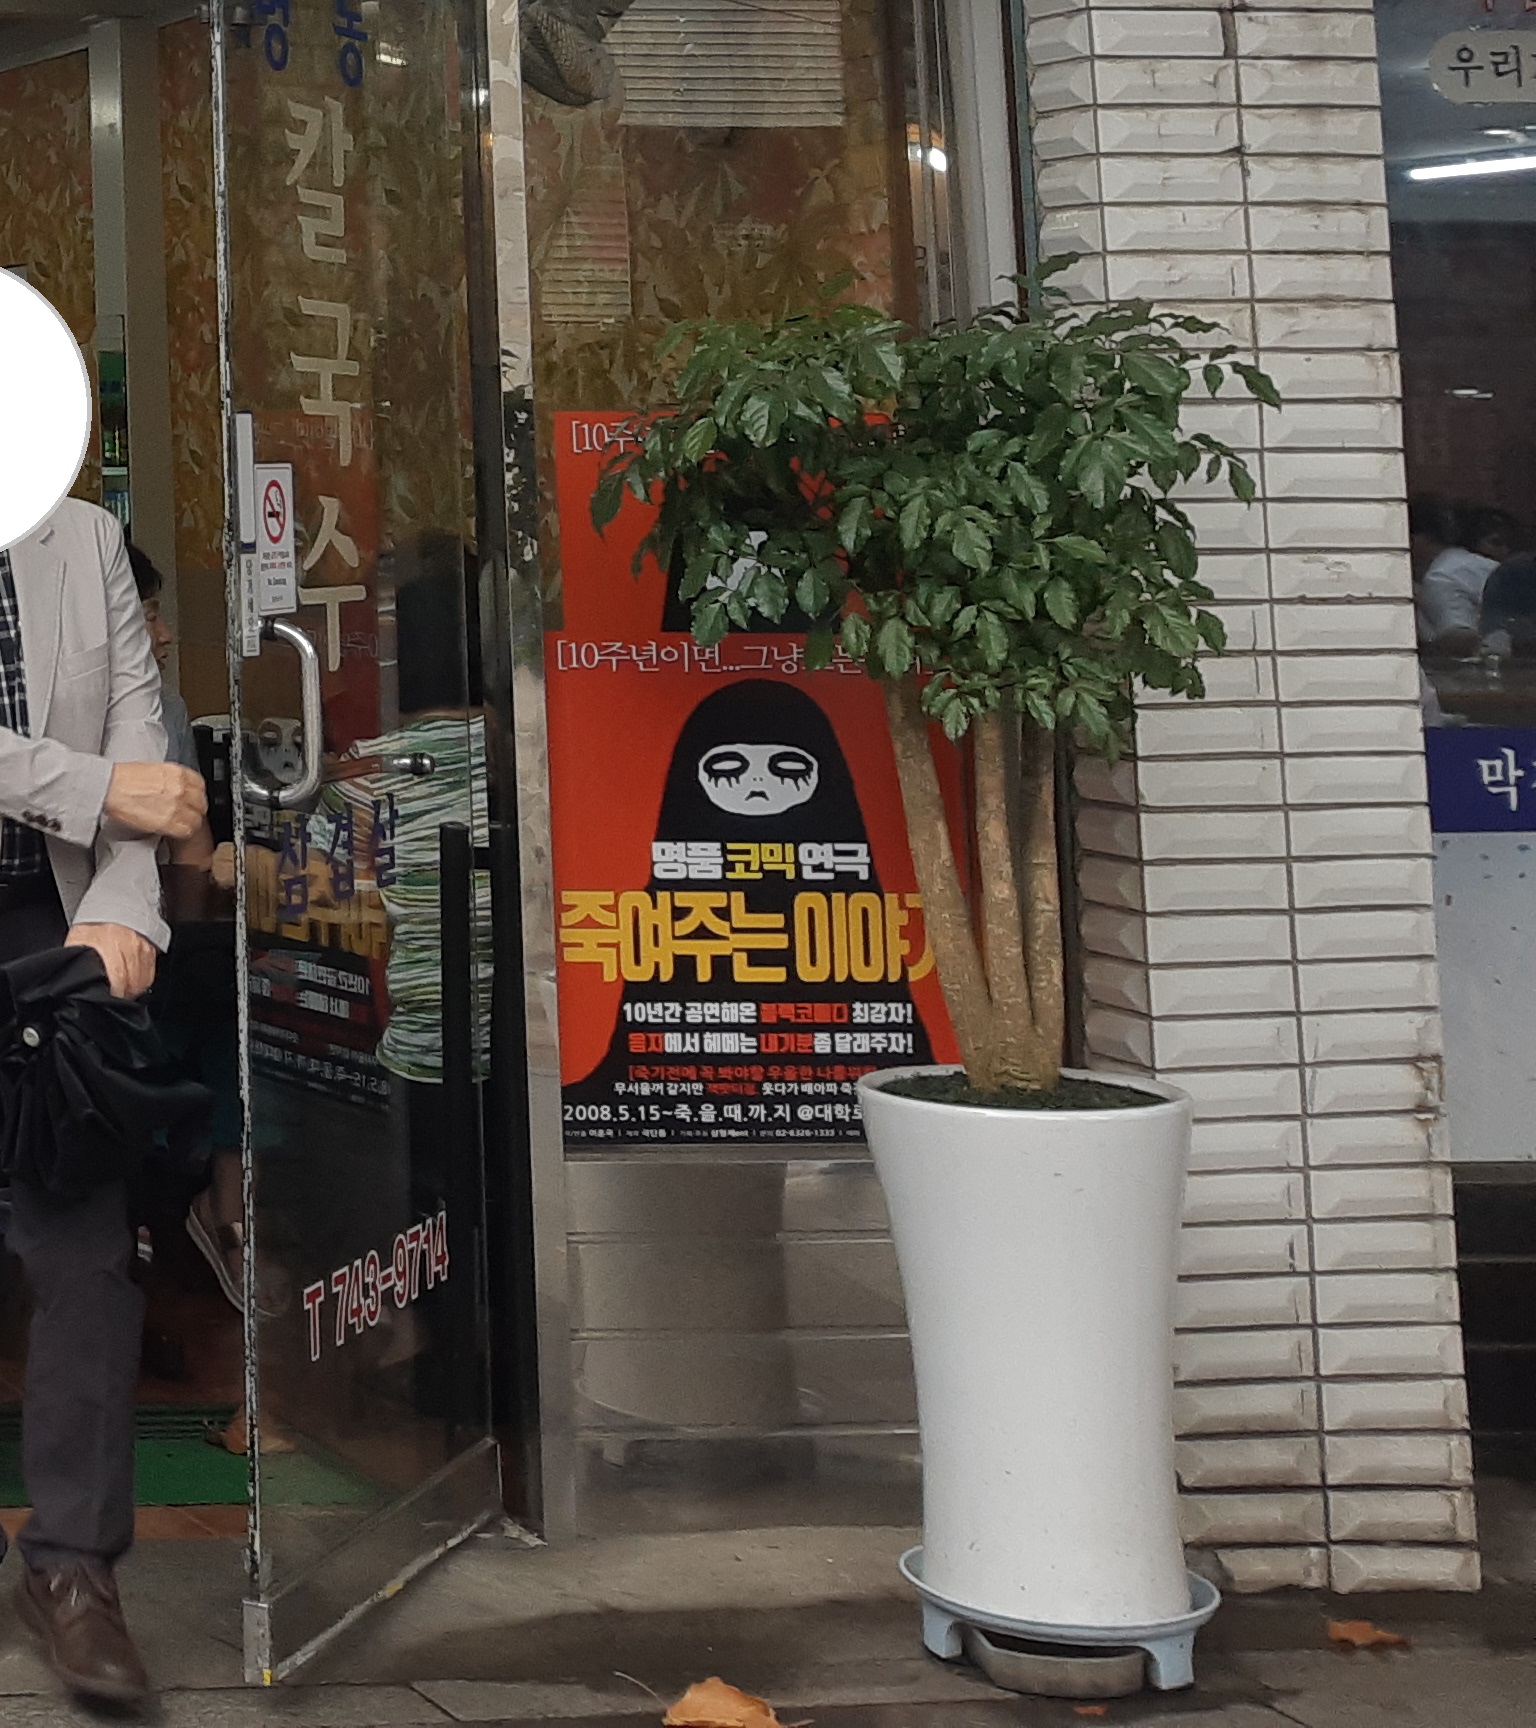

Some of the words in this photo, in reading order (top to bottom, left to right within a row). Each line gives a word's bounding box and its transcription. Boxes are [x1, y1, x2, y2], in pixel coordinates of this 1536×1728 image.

[1448, 42, 1536, 89] 우리
[623, 1002, 681, 1023] 10년간
[685, 1002, 757, 1024] 공연해온
[332, 1210, 450, 1347] 743-9714
